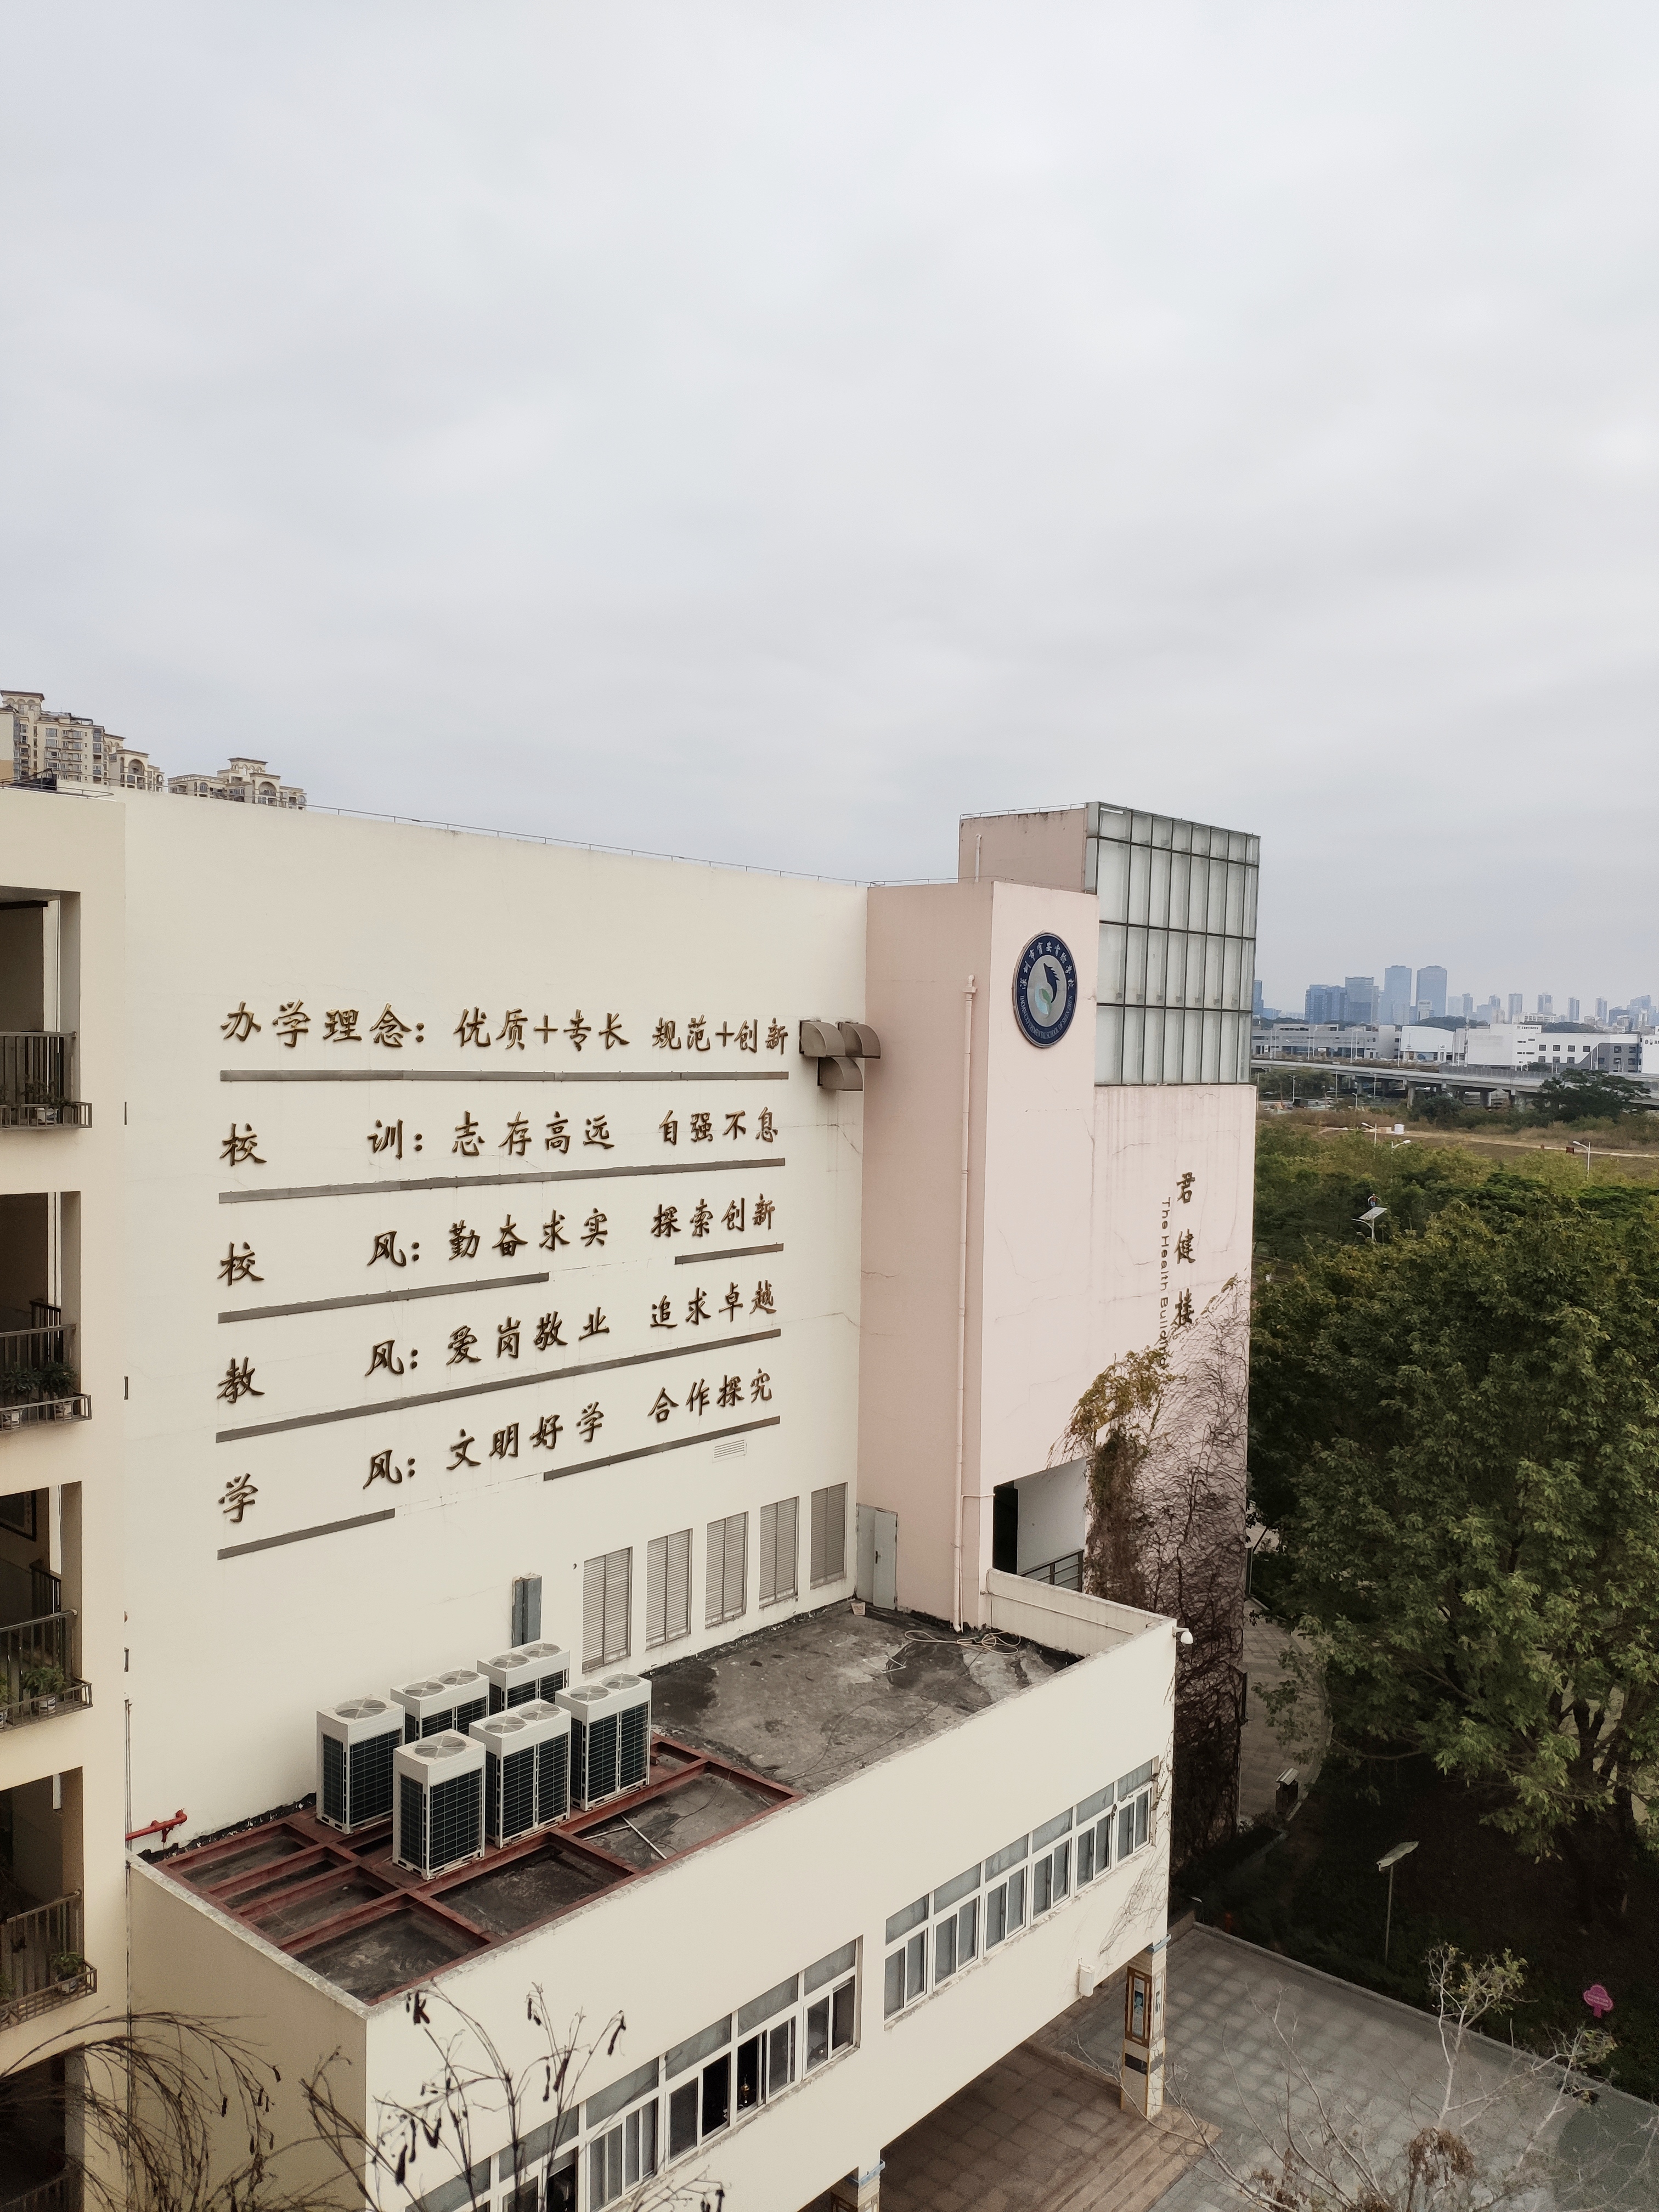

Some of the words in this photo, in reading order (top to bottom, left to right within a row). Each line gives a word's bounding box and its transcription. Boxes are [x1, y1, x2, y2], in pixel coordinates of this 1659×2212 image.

[453, 1006, 631, 1052] 优质+专长
[651, 1014, 789, 1056] 规范+创新
[1023, 1013, 1046, 1039] EXPERIMENTAL
[1046, 1026, 1060, 1039] SCHOOL
[451, 1110, 616, 1158] 志存高远
[658, 1106, 779, 1146] 自强不息
[448, 1207, 608, 1261] 勤奋求实
[650, 1193, 776, 1238] 探索创新
[1160, 1197, 1171, 1229] The
[1159, 1235, 1170, 1291] Health
[445, 1306, 611, 1366] 爱岗敬业
[650, 1279, 777, 1330] 追求卓越
[445, 1401, 605, 1471] 文明好学
[647, 1367, 773, 1424] 合作探究
